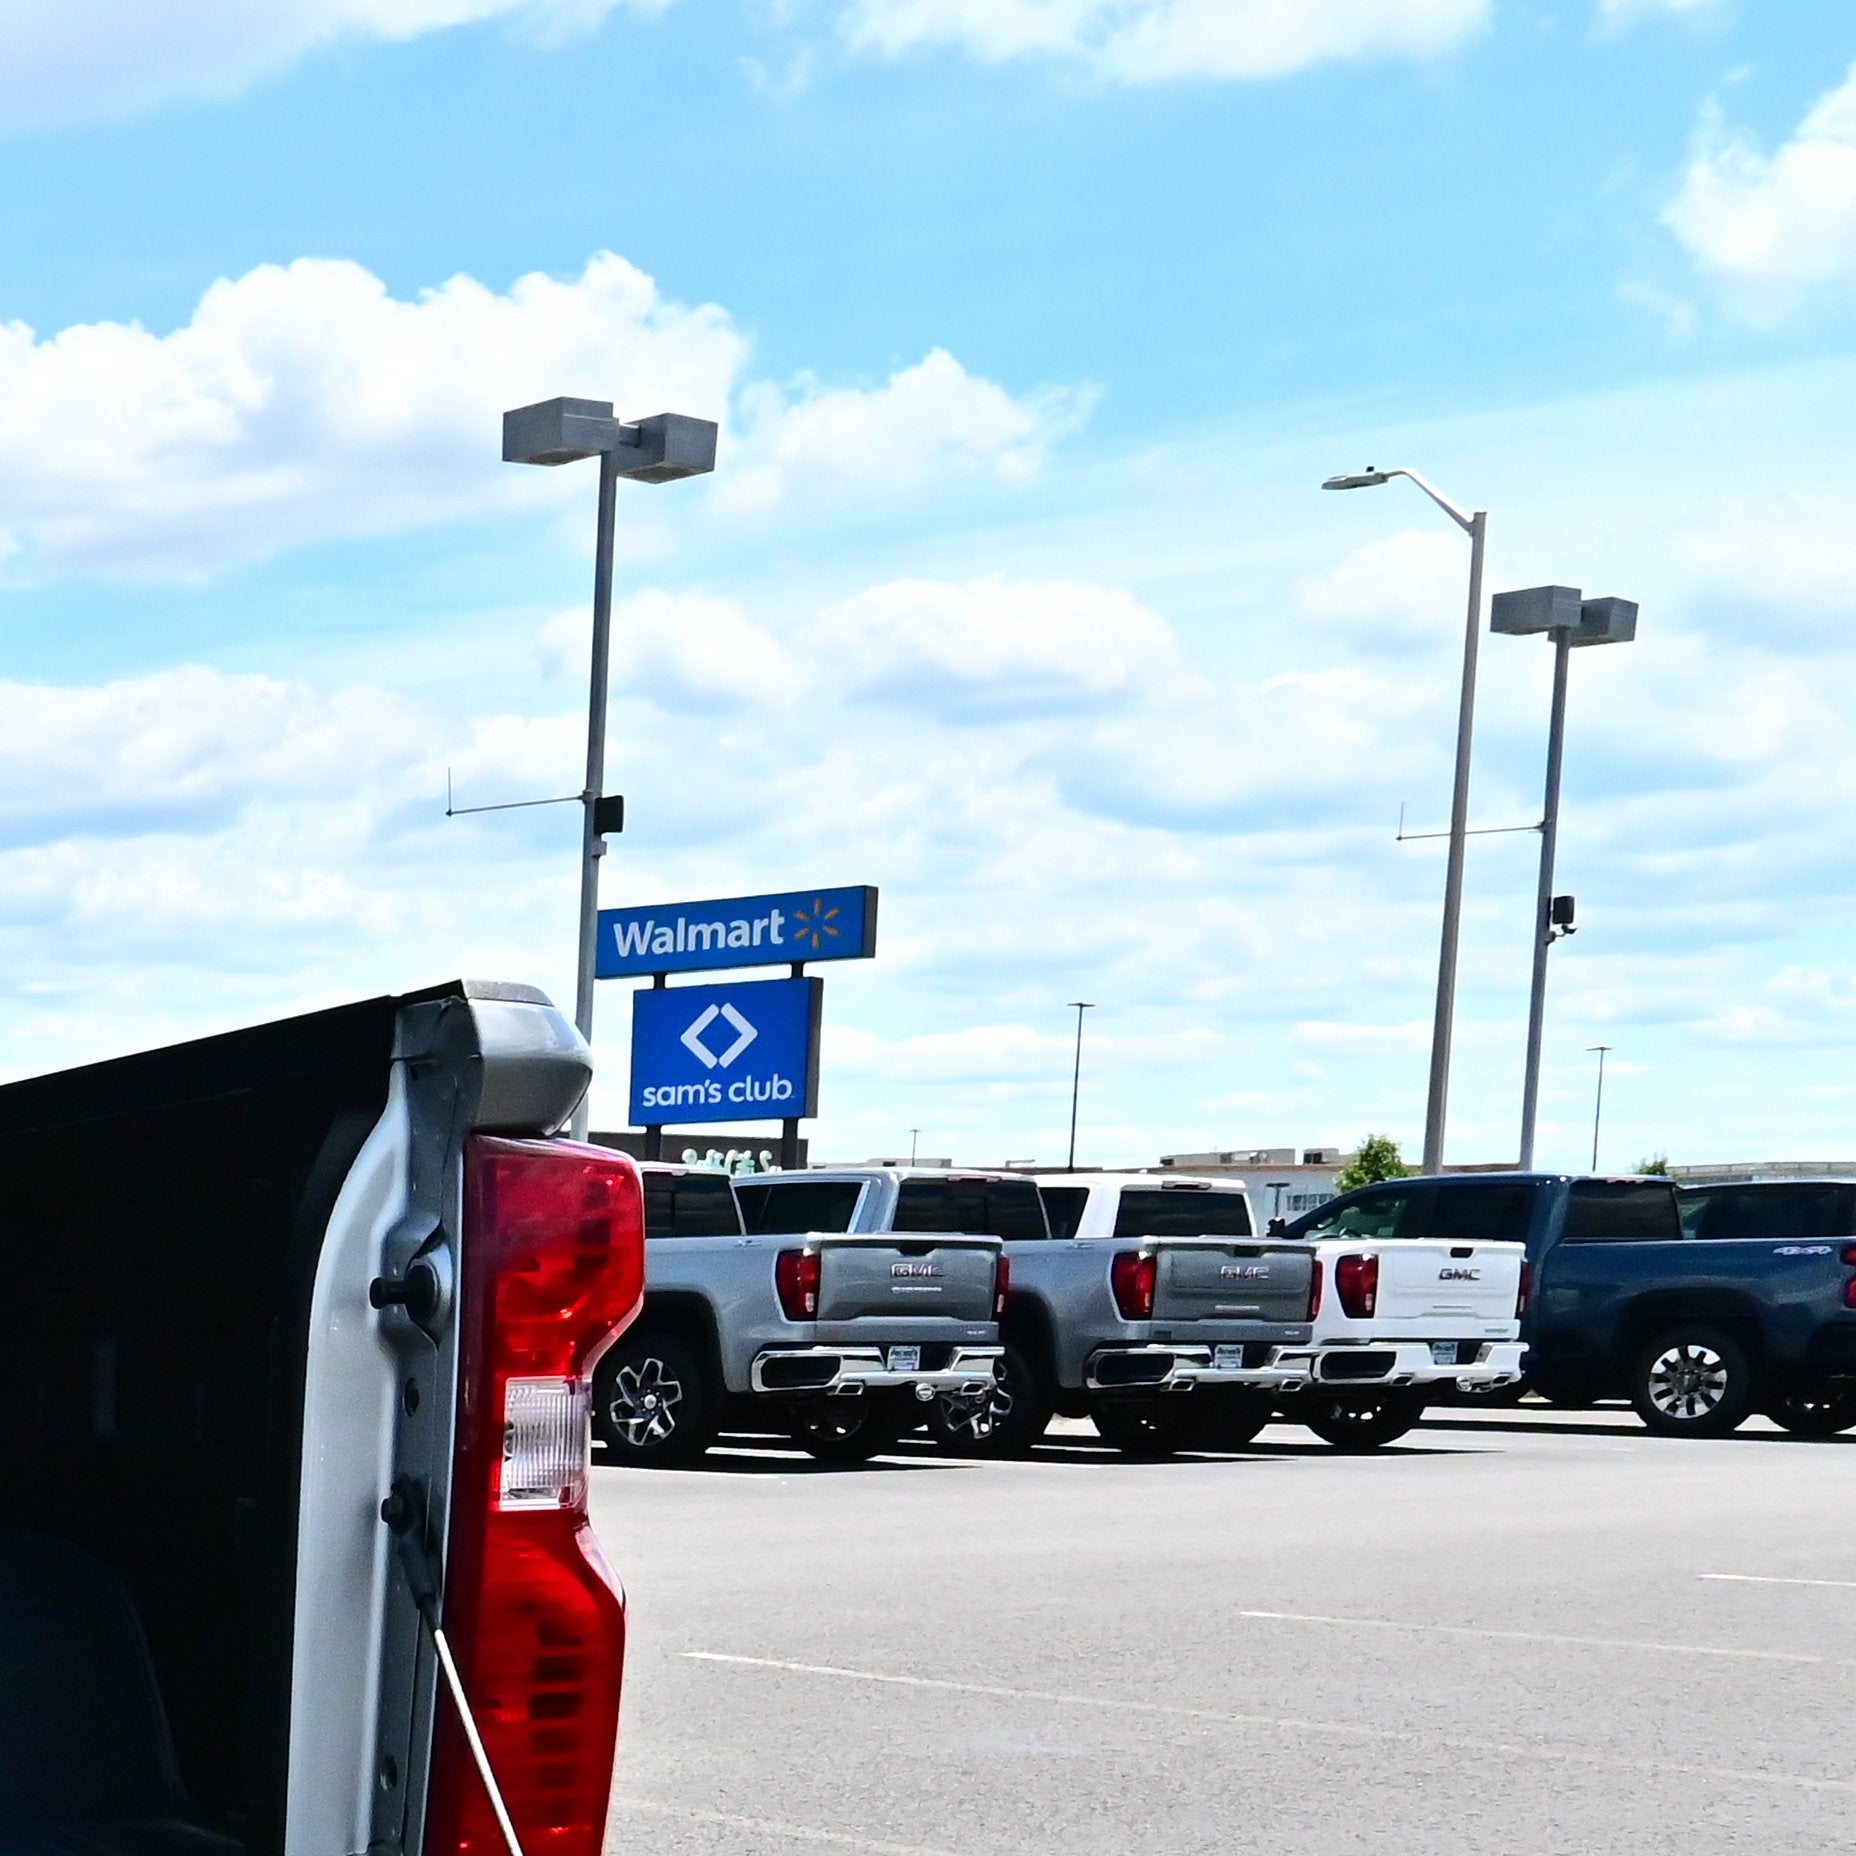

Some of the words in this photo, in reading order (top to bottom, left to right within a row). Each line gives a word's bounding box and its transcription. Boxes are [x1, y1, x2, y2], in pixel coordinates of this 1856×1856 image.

[613, 908, 785, 957] Walmart
[642, 1079, 722, 1107] sam's
[728, 1073, 793, 1101] club
[1439, 1268, 1481, 1280] GMC
